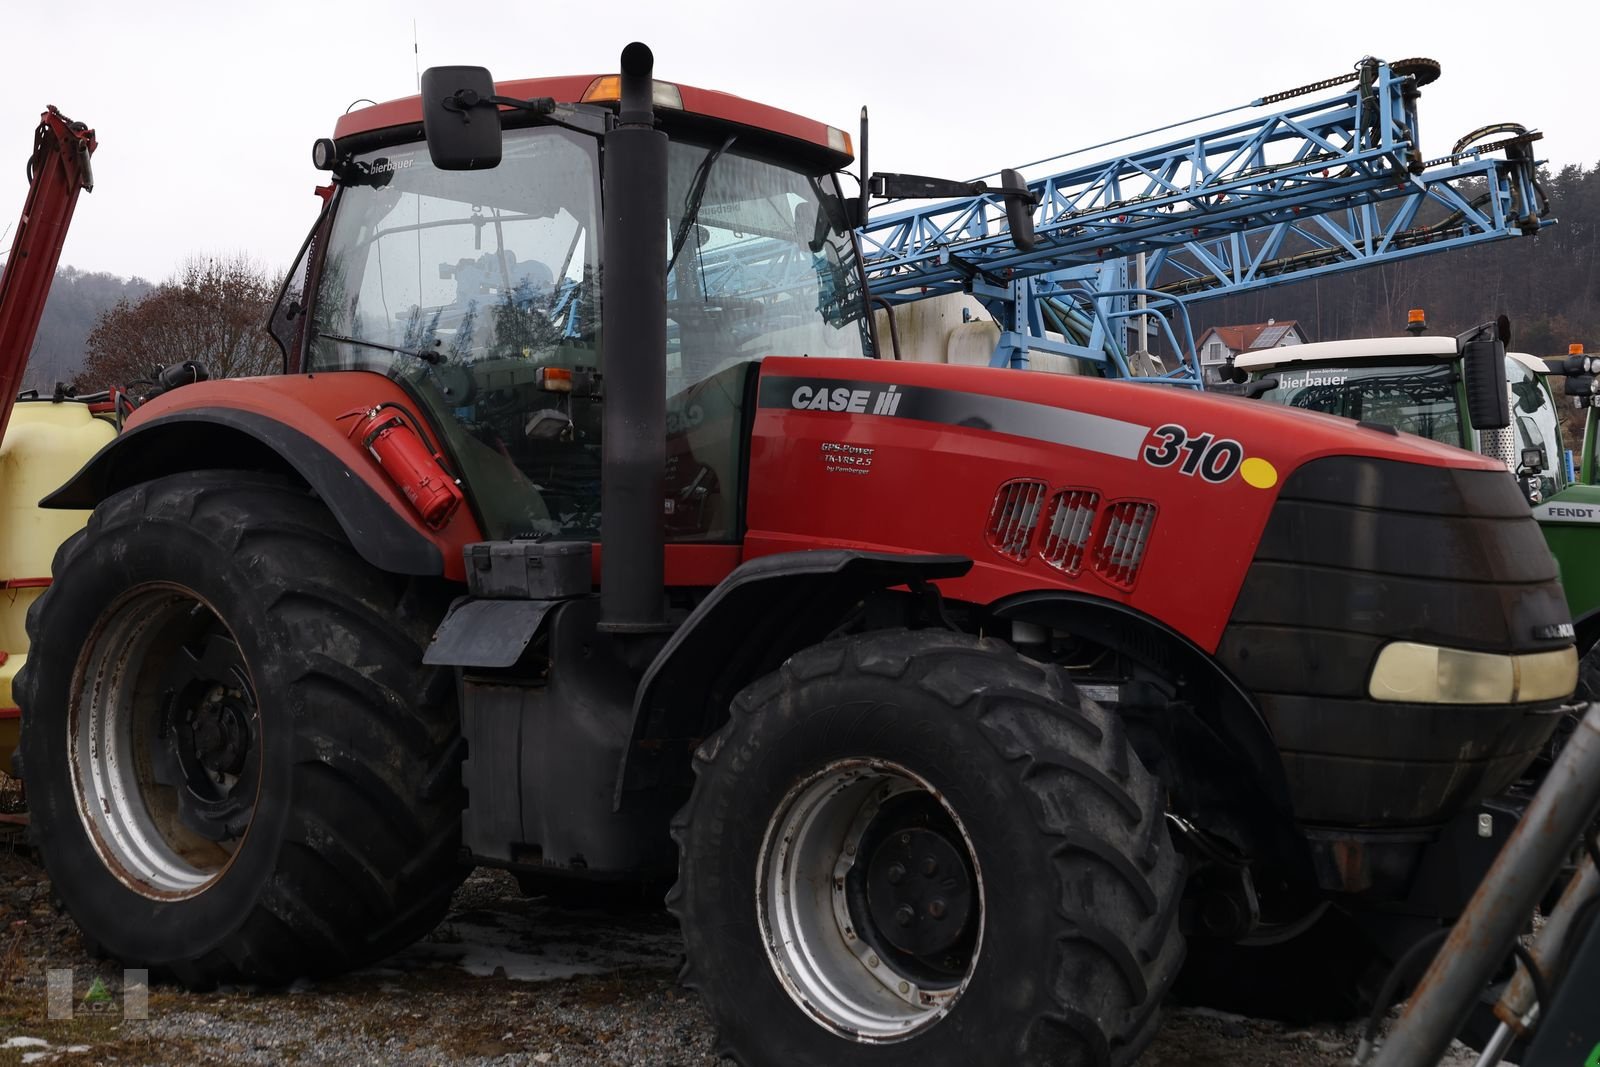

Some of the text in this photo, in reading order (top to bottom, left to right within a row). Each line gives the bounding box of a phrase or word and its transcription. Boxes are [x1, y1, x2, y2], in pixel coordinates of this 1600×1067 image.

[370, 157, 414, 175] bierbauer
[1280, 370, 1348, 390] bierbauer
[791, 385, 871, 413] CASE
[856, 457, 872, 466] 2.5
[1143, 423, 1243, 484] 310
[1548, 507, 1593, 518] FENDT
